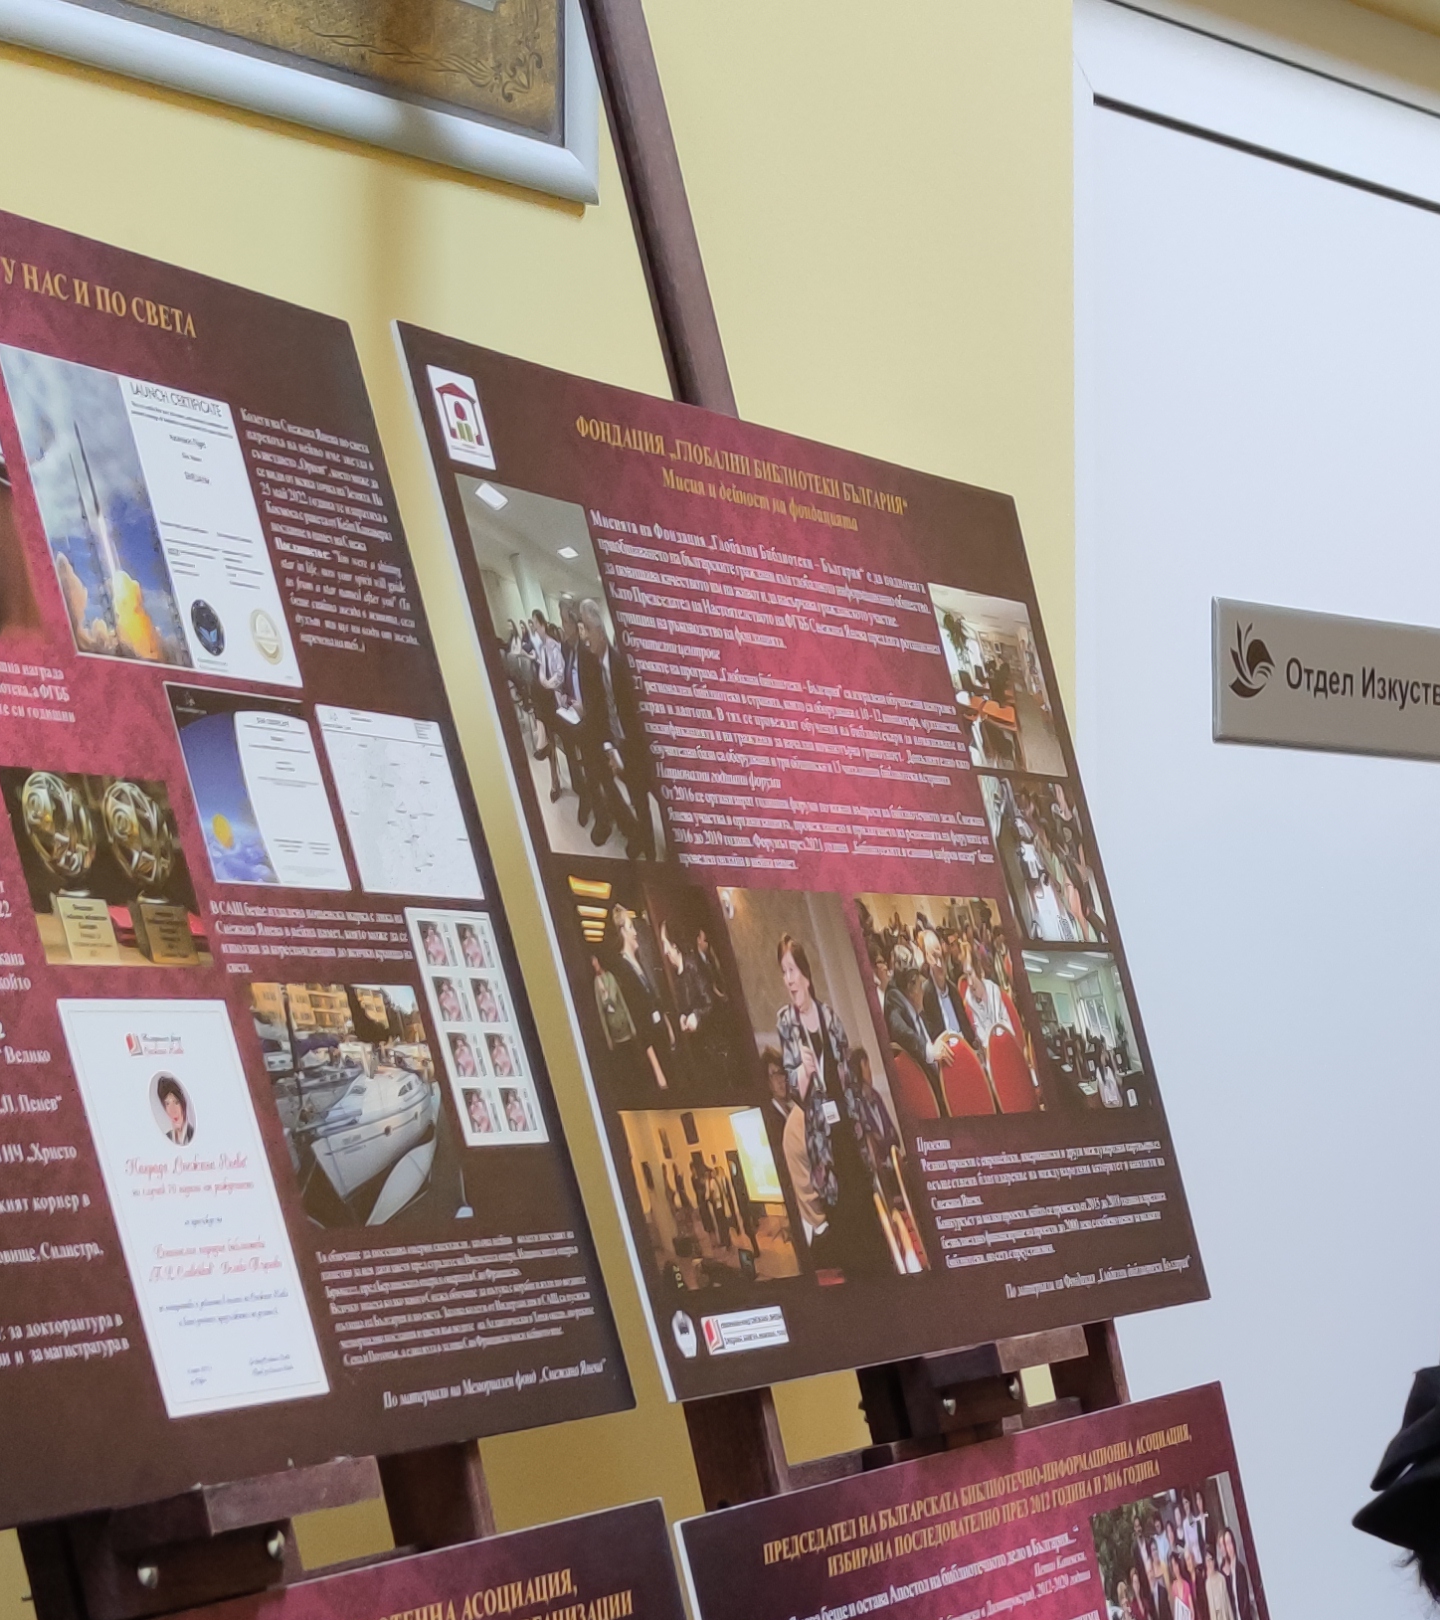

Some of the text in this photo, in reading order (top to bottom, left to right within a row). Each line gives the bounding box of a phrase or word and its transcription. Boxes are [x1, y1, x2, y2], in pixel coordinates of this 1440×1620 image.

[0, 253, 17, 285] У
[20, 259, 64, 298] НАС
[72, 274, 90, 306] И
[93, 281, 128, 317] ПО
[129, 292, 195, 338] СВЕТА
[574, 414, 665, 457] ФОНДАЦИЯ
[752, 459, 840, 500] БИБЛИОТЕКИ
[661, 468, 858, 531] Мисия и дейност на фондацията
[1286, 657, 1353, 700] Отдел
[31, 1195, 81, 1212] корнер
[24, 1315, 113, 1339] докторантура
[762, 1425, 1192, 1565] ПРЕДСЕДАТЕЛ НА БЪЛГАРСКАТА БИБЛИОТЕЧНО-ИНФОРМАЦИОННА АСОЦИАЦИЯ,
[827, 1458, 1159, 1577] ИЗБИРАНА ПОСЛЕДОВАТЕЛНО ПРЕЗ 2012 ГОДИНА И 2016 ГОДИНА
